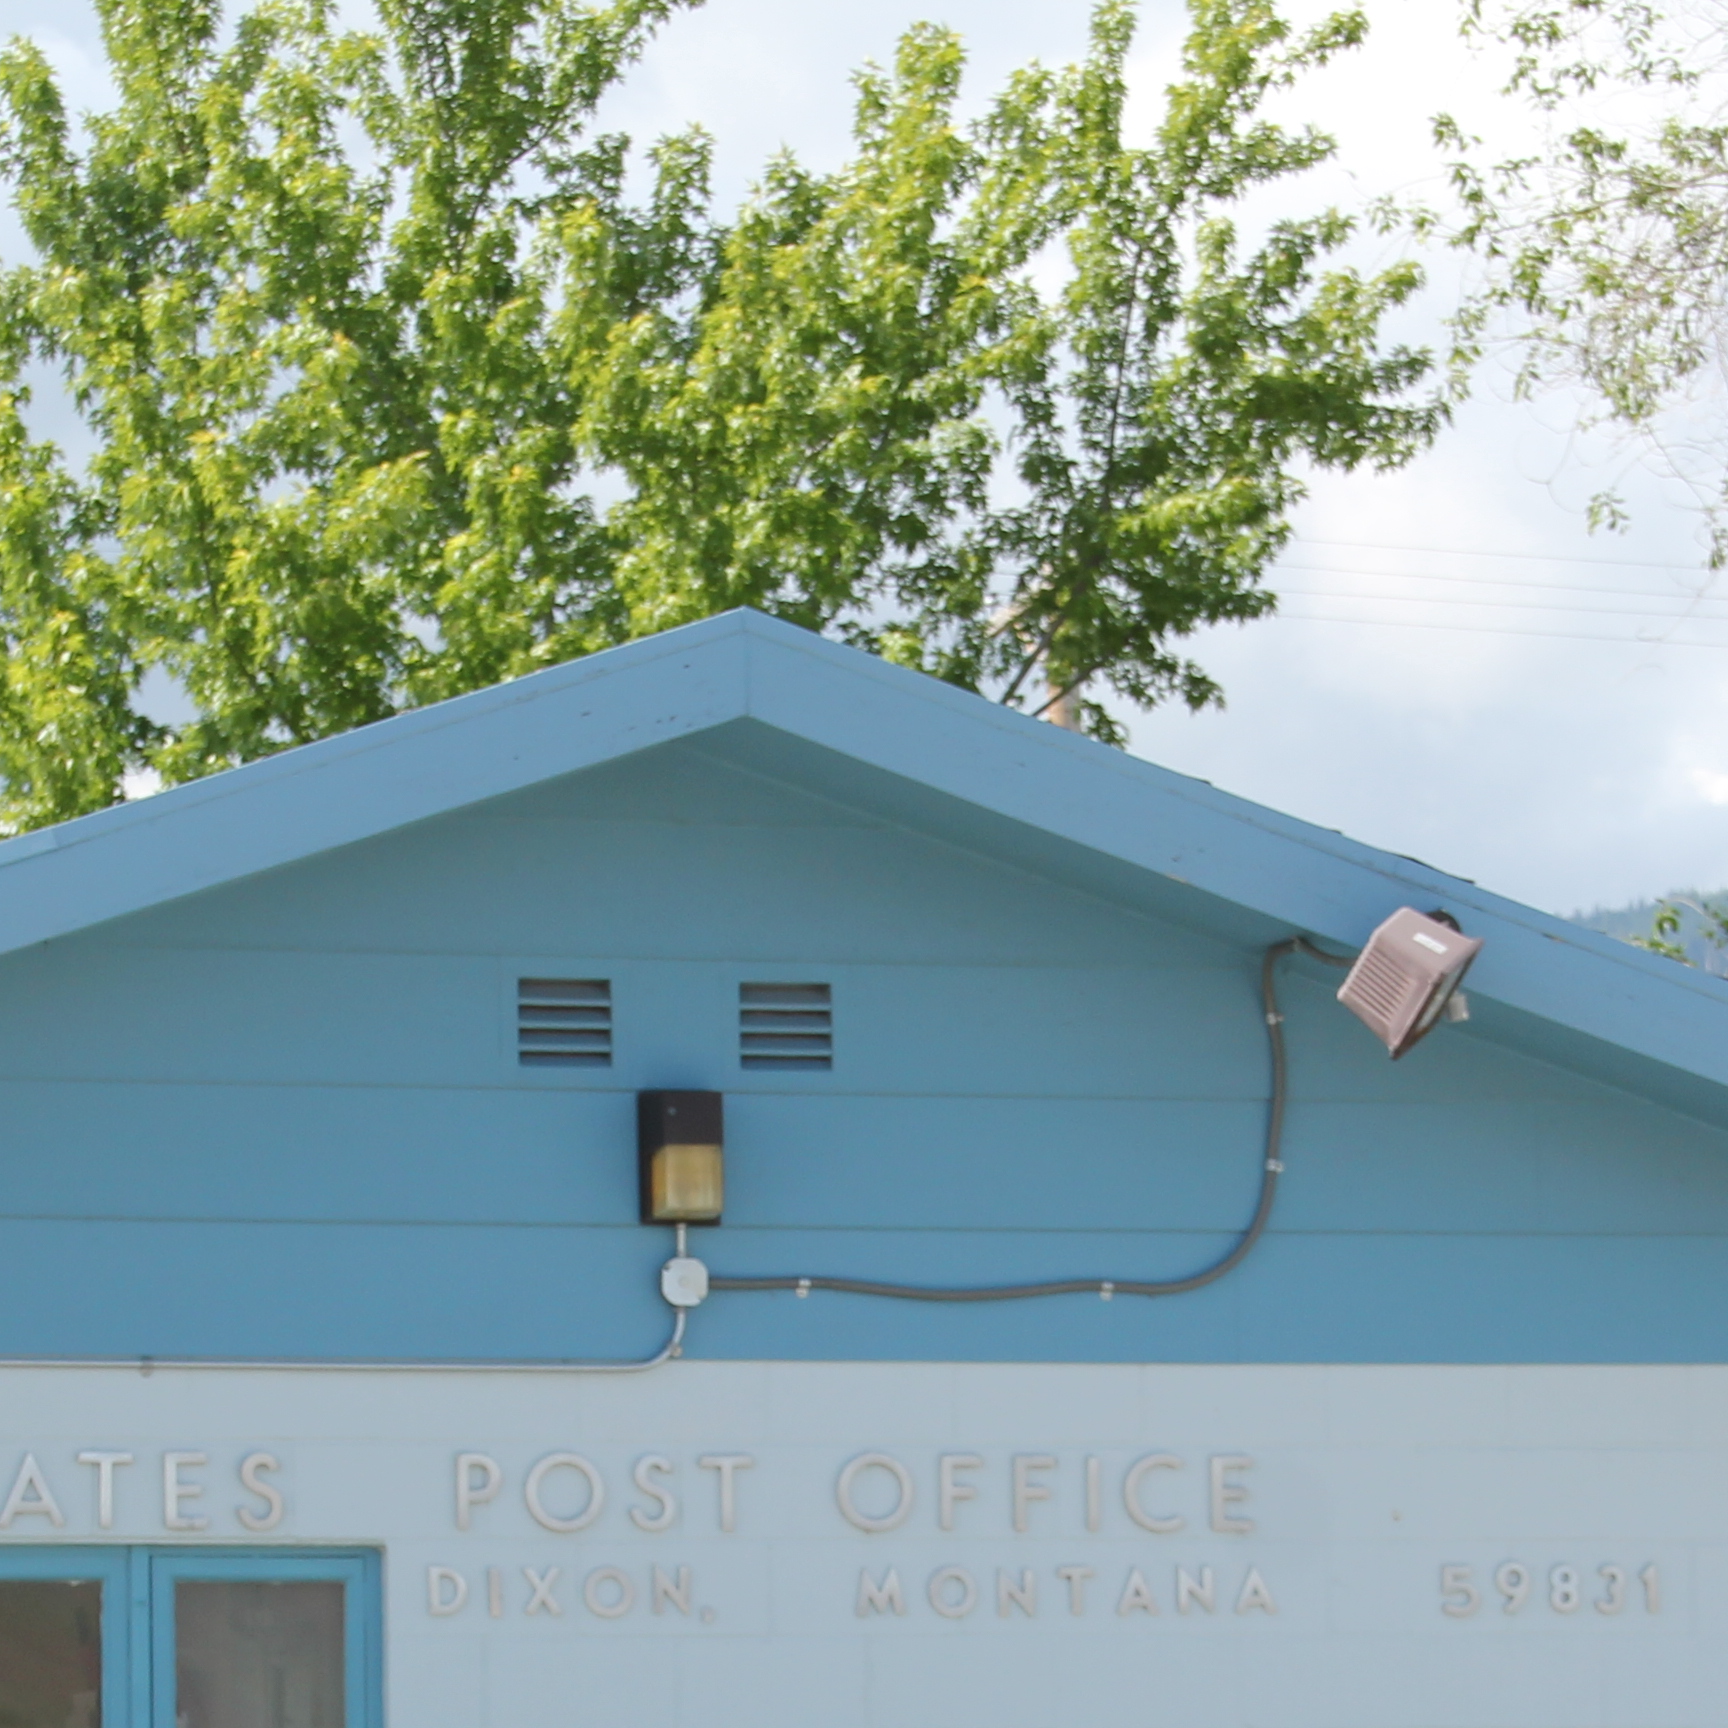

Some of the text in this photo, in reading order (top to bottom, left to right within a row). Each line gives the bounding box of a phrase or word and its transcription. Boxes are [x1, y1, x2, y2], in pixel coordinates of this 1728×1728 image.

[454, 1450, 754, 1534] POST
[836, 1452, 1258, 1534] OFFICE
[426, 1560, 1661, 1624] DIXON, MONTANA 59831
